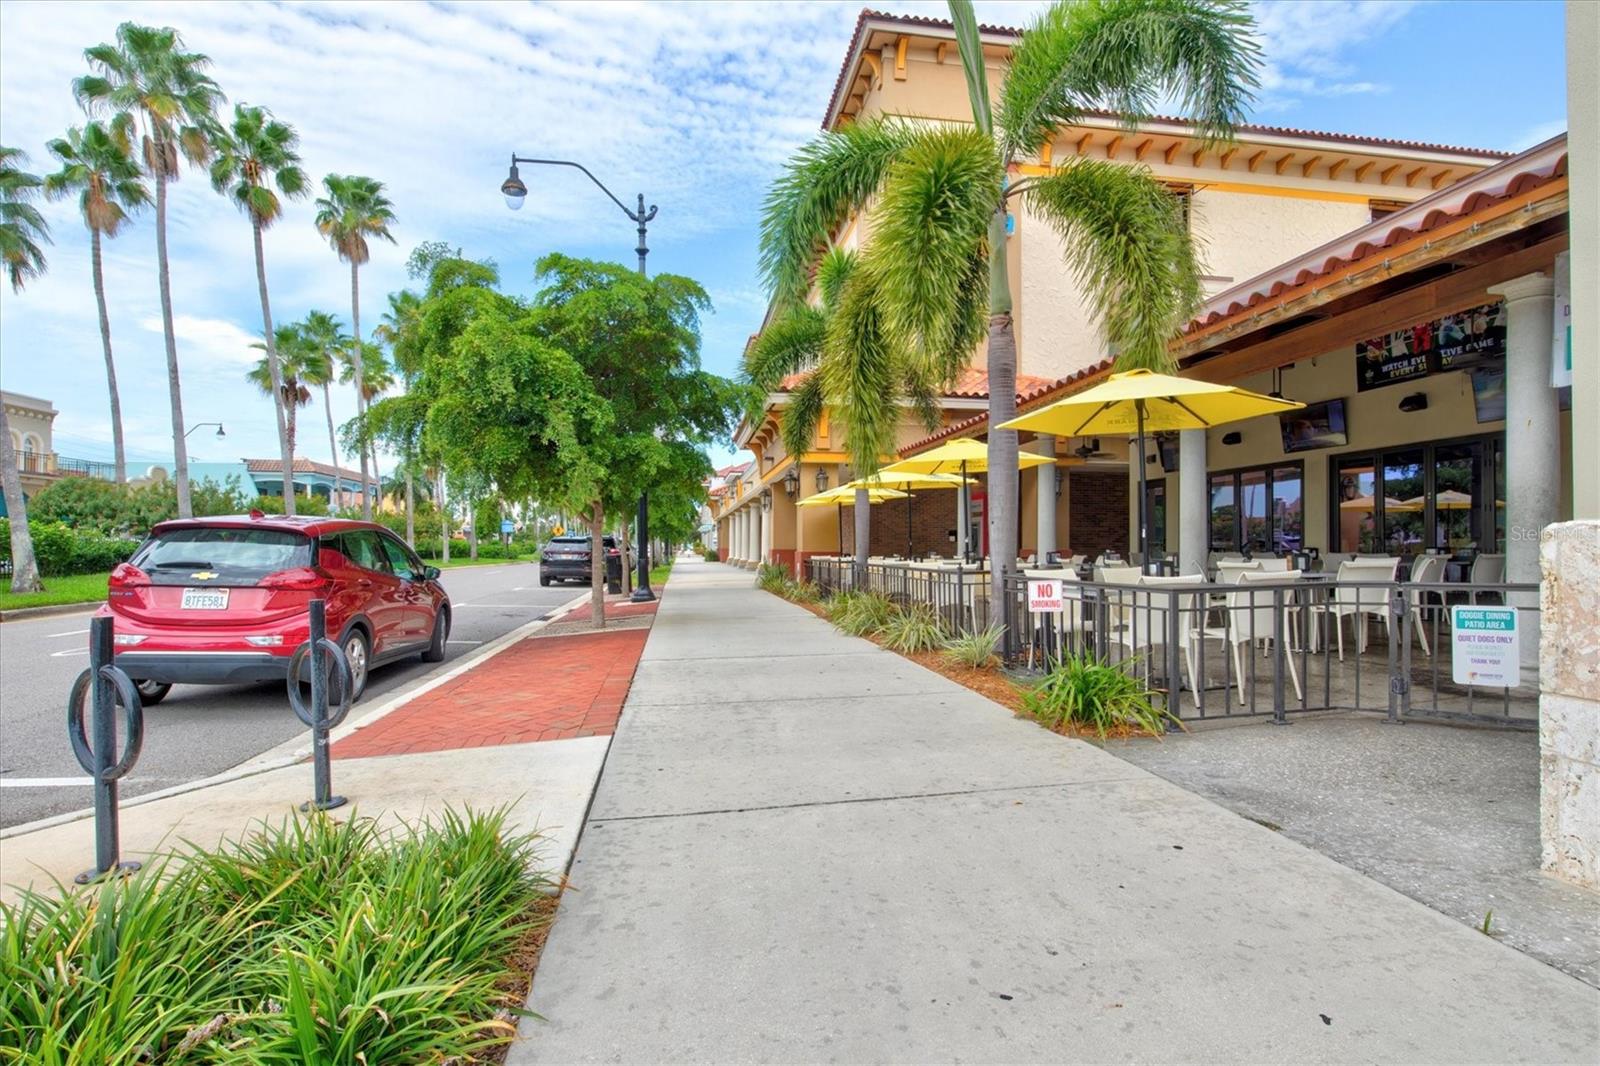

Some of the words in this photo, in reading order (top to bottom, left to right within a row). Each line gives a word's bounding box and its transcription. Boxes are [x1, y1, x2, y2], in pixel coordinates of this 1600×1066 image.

[1381, 360, 1408, 373] WATCH
[1440, 345, 1463, 358] LIVE
[1390, 366, 1416, 378] EVERY
[1037, 584, 1053, 598] NO
[1031, 600, 1061, 608] SMOKING
[1459, 611, 1485, 619] DOGGIE
[1485, 612, 1511, 620] DINING
[1464, 620, 1485, 628] PATIO
[1485, 621, 1506, 629] AREA
[1457, 634, 1476, 642] QUIET
[1477, 635, 1495, 643] DOGS
[1496, 636, 1513, 644] ONLY
